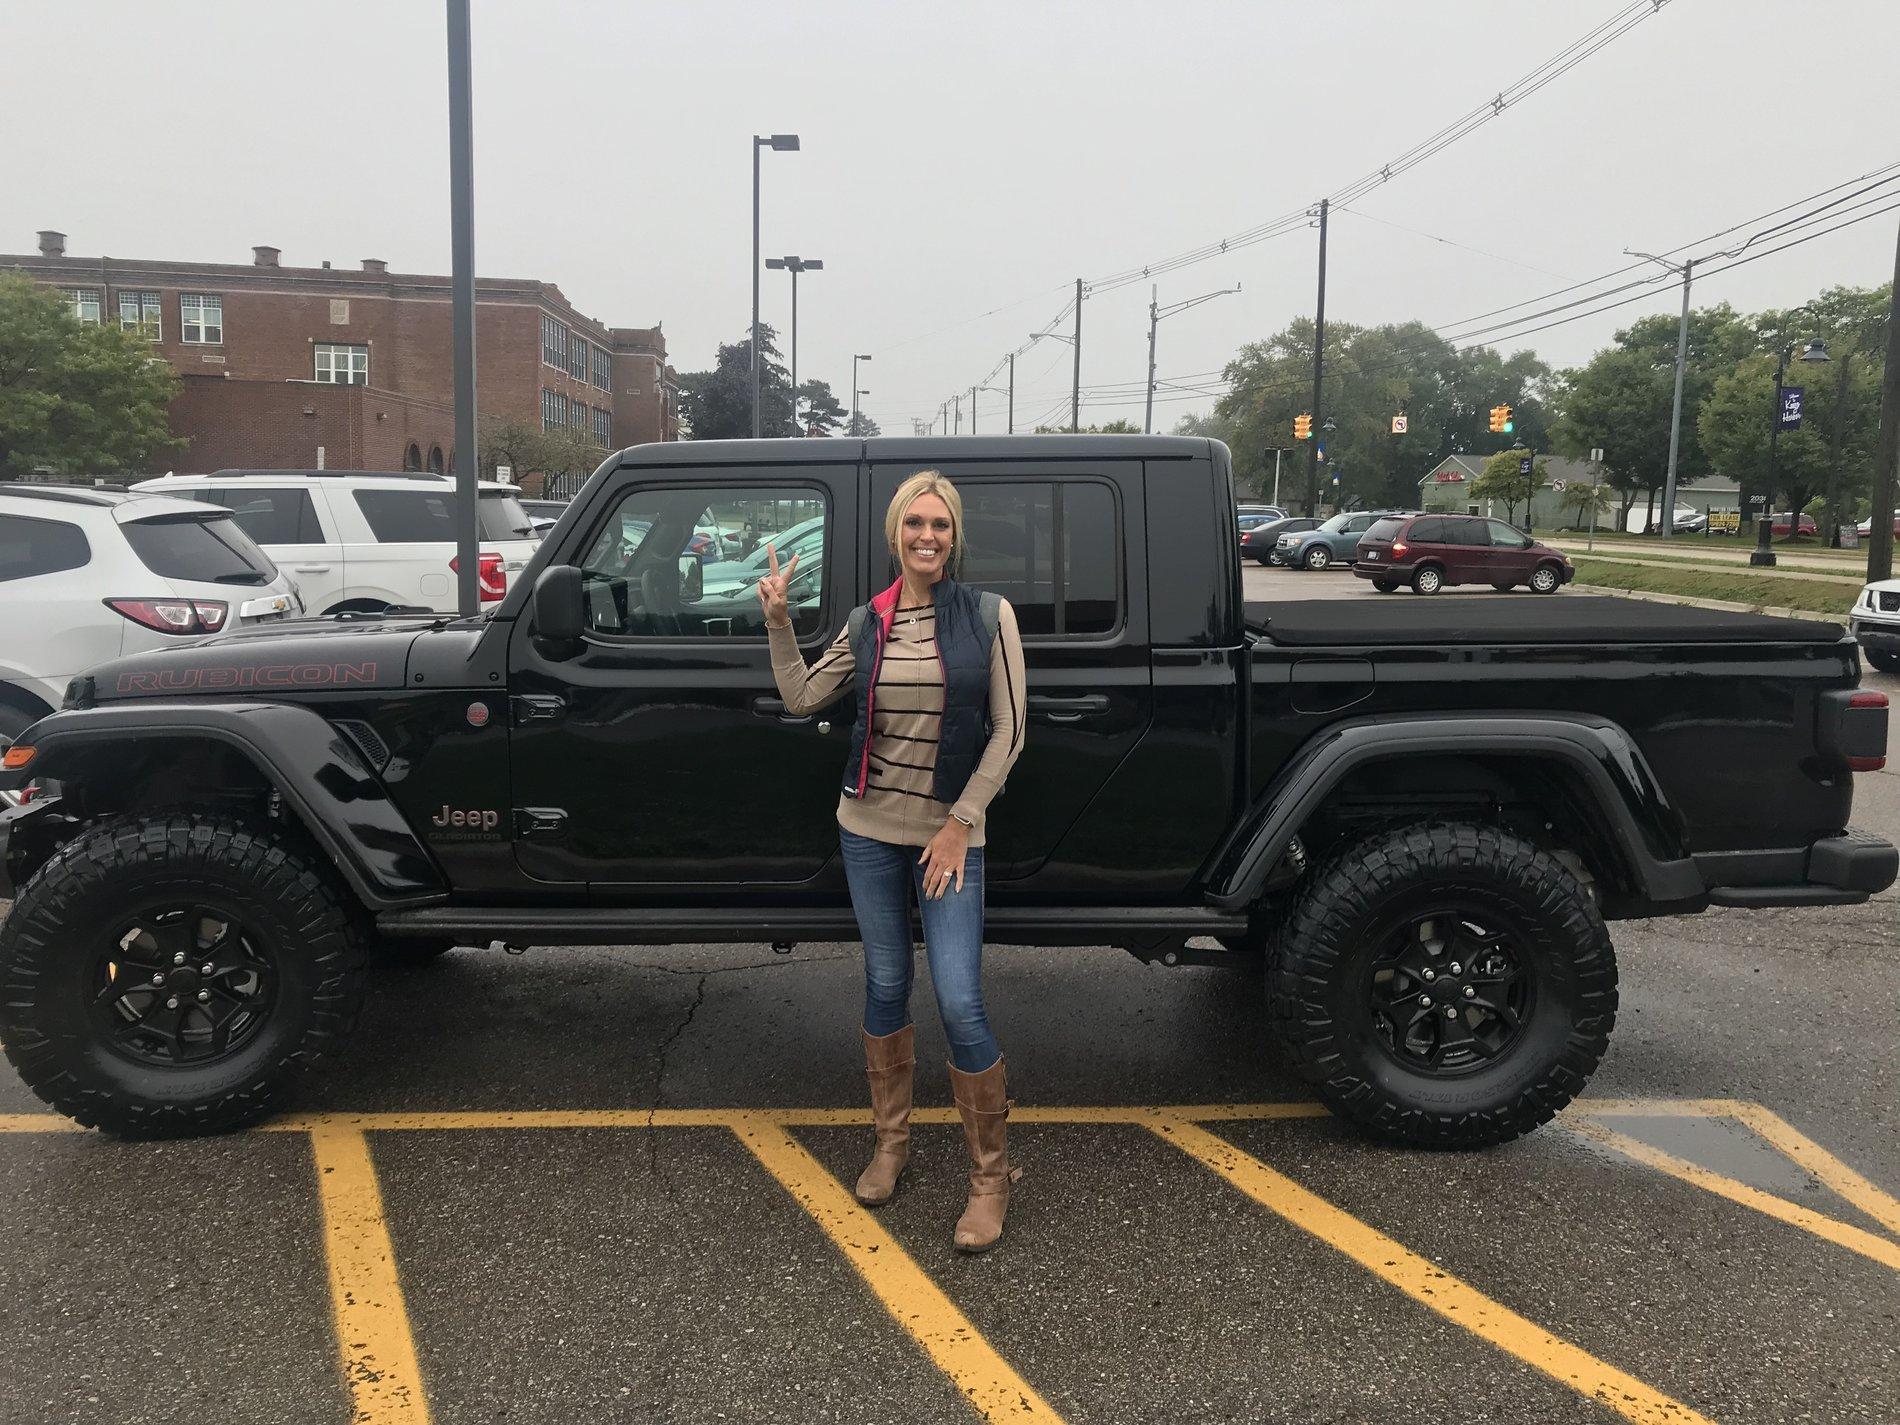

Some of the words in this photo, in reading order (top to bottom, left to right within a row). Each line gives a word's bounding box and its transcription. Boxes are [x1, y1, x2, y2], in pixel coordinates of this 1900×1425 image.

[117, 662, 376, 692] RUBICON
[432, 805, 498, 831] Jeep
[428, 832, 502, 840] GLADIATOR
